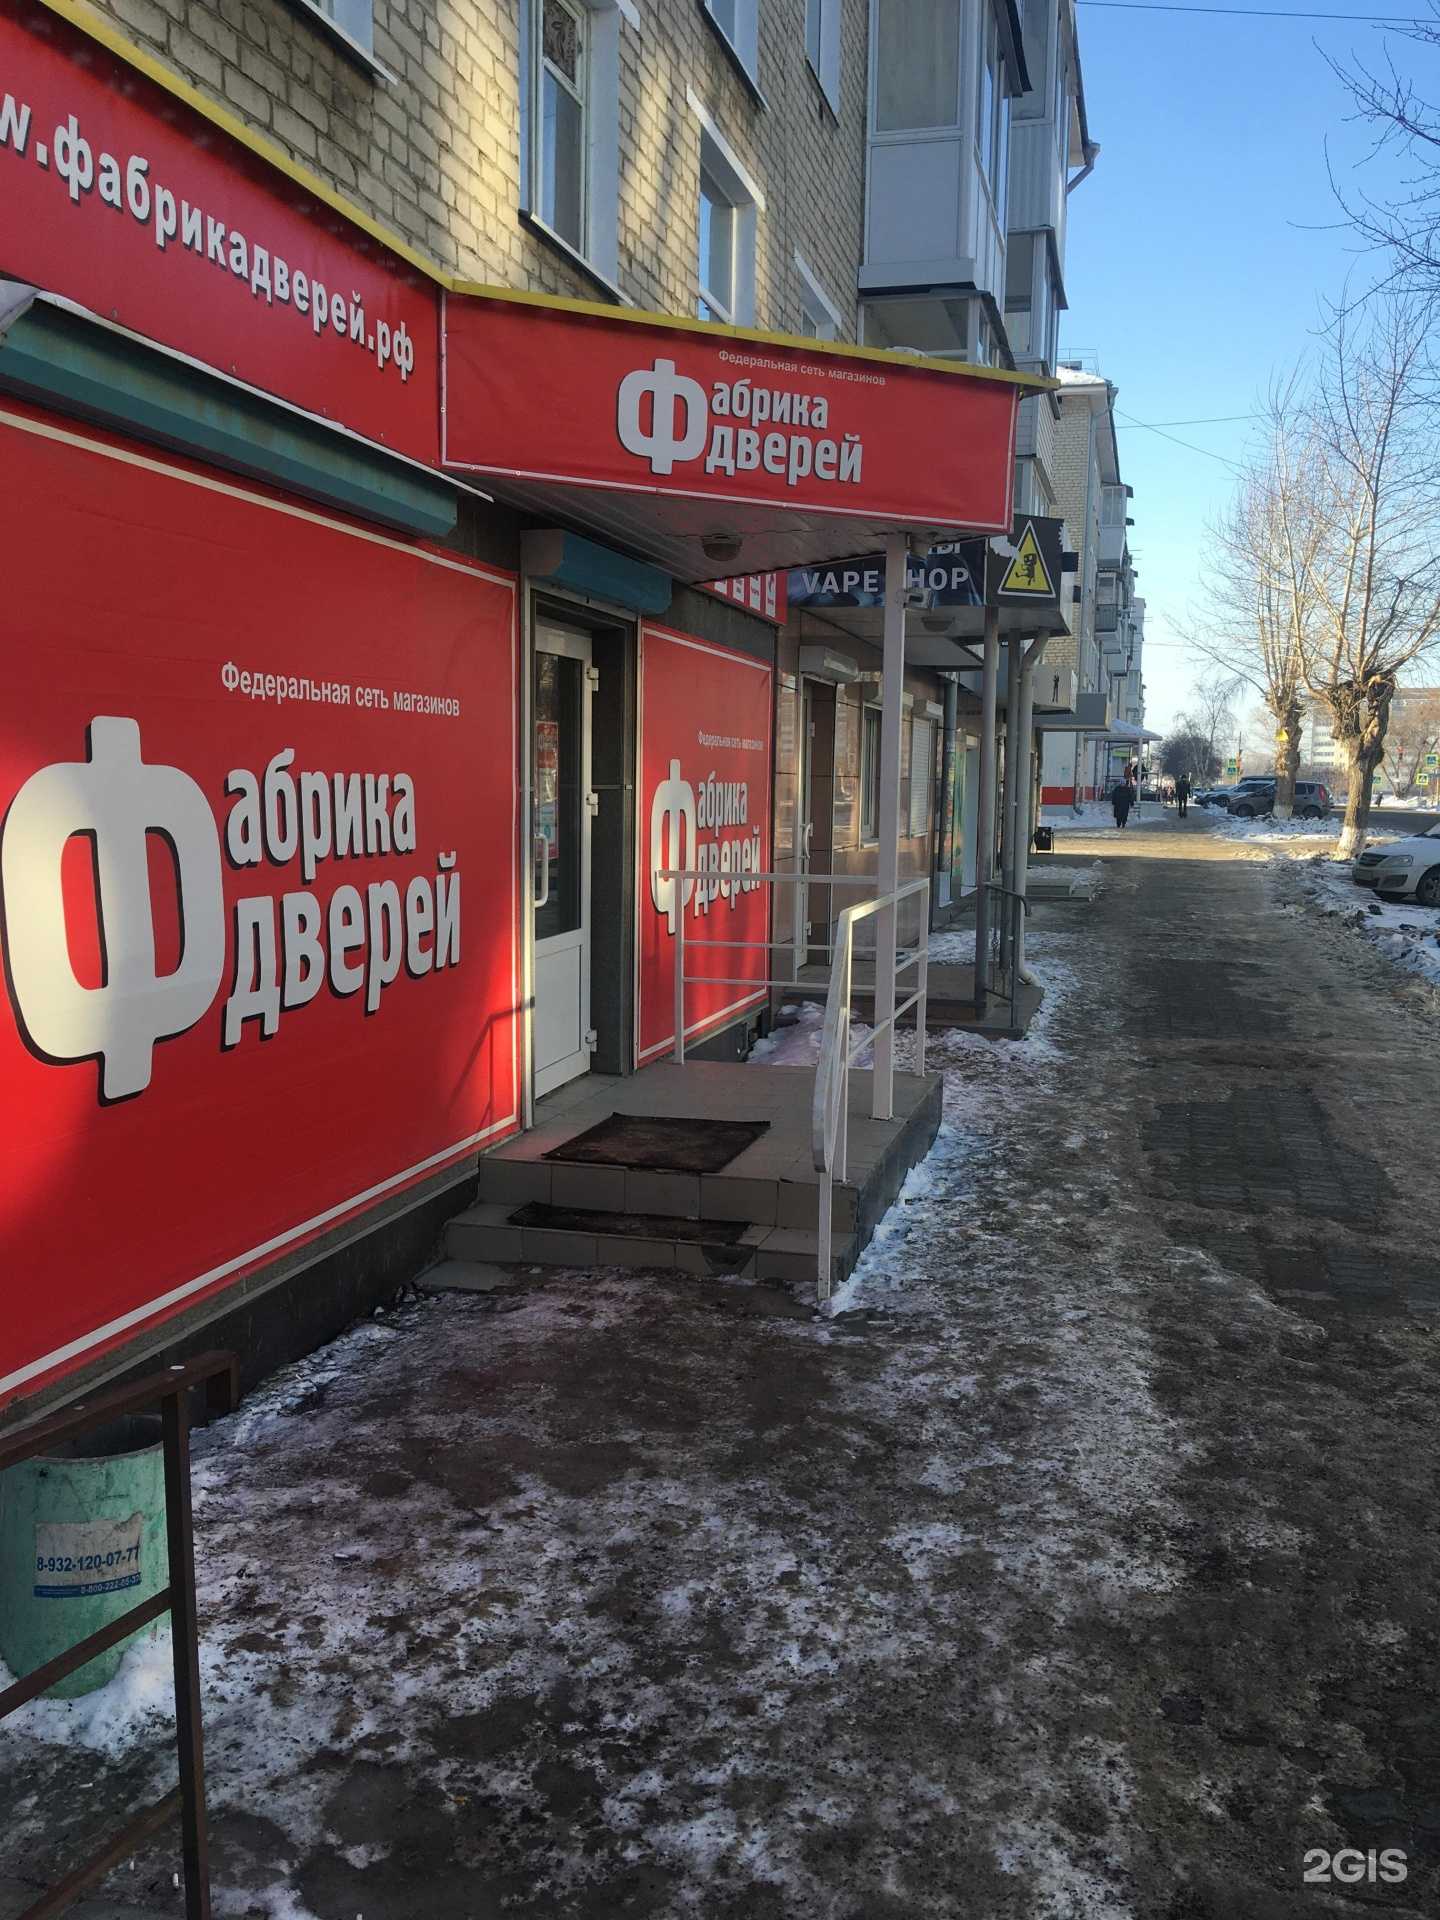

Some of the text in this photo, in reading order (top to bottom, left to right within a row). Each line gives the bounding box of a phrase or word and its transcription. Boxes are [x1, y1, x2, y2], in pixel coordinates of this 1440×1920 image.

[718, 350, 886, 386] Федеральная сеть магазинов
[617, 359, 829, 475] Фабрика
[705, 432, 863, 486] дверей
[802, 567, 970, 594] VAPE HOP
[220, 661, 460, 717] Федеральная сеть магазинов
[0, 715, 417, 1100] Фабрика
[694, 825, 761, 917] дверей
[224, 850, 461, 1047] дверей
